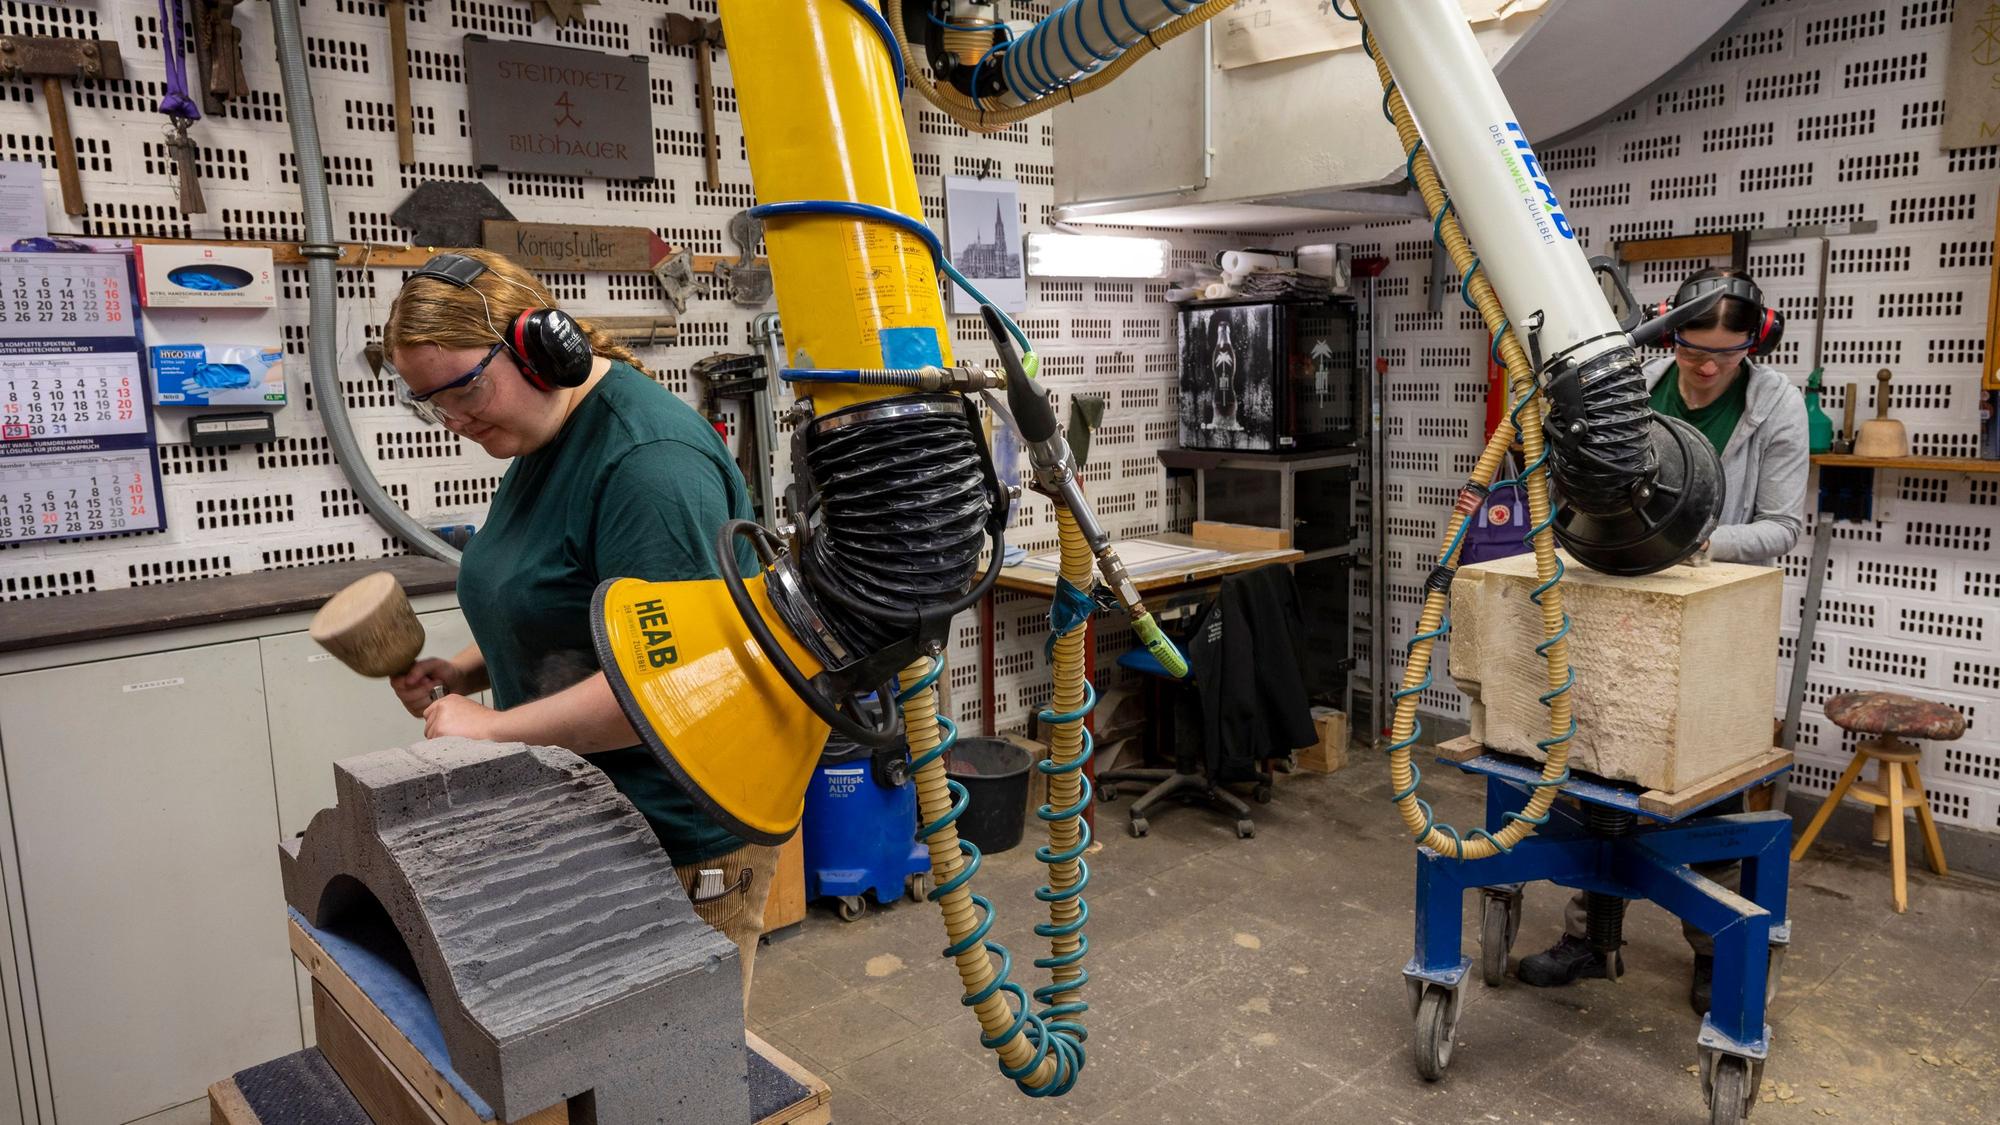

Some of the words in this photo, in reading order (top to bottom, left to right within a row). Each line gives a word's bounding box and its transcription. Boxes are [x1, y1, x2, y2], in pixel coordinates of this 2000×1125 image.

[498, 61, 629, 91] STEINMETZ
[509, 134, 629, 160] BILDHAUER
[1489, 124, 1506, 146] DER
[1501, 148, 1530, 194] UMWELT
[18, 277, 26, 287] 5
[42, 278, 50, 287] 6
[64, 278, 72, 288] 7
[262, 271, 269, 280] S
[12, 289, 27, 299] 12
[36, 289, 51, 299] 13
[59, 290, 74, 299] 14
[82, 290, 97, 299] 15
[104, 290, 119, 299] 16
[14, 300, 29, 310] 19
[37, 301, 52, 310] 20
[60, 301, 75, 310] 21
[83, 301, 97, 310] 22
[105, 301, 120, 310] 23
[14, 312, 31, 322] 26
[38, 312, 53, 322] 27
[61, 312, 77, 322] 28
[84, 312, 99, 322] 29
[106, 312, 121, 322] 30
[8, 381, 15, 390] 1
[31, 380, 39, 390] 2
[55, 380, 62, 389] 3
[77, 379, 85, 388] 4
[100, 378, 107, 387] 5
[121, 377, 129, 387] 6
[9, 392, 17, 402] 8
[32, 391, 41, 401] 9
[49, 391, 64, 400] 10
[72, 390, 86, 400] 11
[94, 389, 109, 399] 12
[117, 388, 130, 398] 13
[4, 404, 19, 413] 15
[27, 403, 42, 413] 16
[51, 402, 64, 412] 17
[74, 401, 88, 411] 18
[96, 400, 110, 410] 19
[118, 399, 132, 409] 20
[4, 416, 20, 425] 22
[28, 414, 44, 424] 23
[51, 413, 67, 423] 24
[74, 412, 89, 422] 25
[97, 411, 111, 421] 26
[119, 410, 133, 420] 27
[7, 427, 22, 436] 29
[30, 425, 45, 435] 30
[53, 424, 68, 434] 31
[91, 477, 97, 486] 1
[112, 476, 119, 484] 2
[134, 474, 141, 483] 3
[0, 494, 8, 504] 4
[23, 493, 31, 502] 5
[46, 491, 54, 500] 6
[69, 490, 76, 499] 7
[91, 488, 99, 497] 8
[114, 486, 121, 495] 9
[128, 485, 143, 494] 10
[18, 505, 33, 514] 12
[41, 502, 56, 512] 13
[64, 501, 79, 510] 14
[86, 499, 101, 508] 15
[108, 498, 122, 506] 16
[130, 496, 143, 505] 17
[20, 515, 34, 525] 19
[42, 513, 57, 523] 20
[65, 512, 79, 521] 21
[87, 510, 102, 519] 22
[110, 508, 124, 517] 23
[130, 506, 145, 516] 24
[20, 526, 36, 536] 26
[44, 525, 58, 534] 27
[66, 522, 82, 532] 28
[89, 520, 104, 530] 29
[111, 519, 126, 528] 30
[634, 599, 678, 668] HEAB
[828, 776, 864, 785] Nilfisk
[829, 784, 856, 793] ALTO
